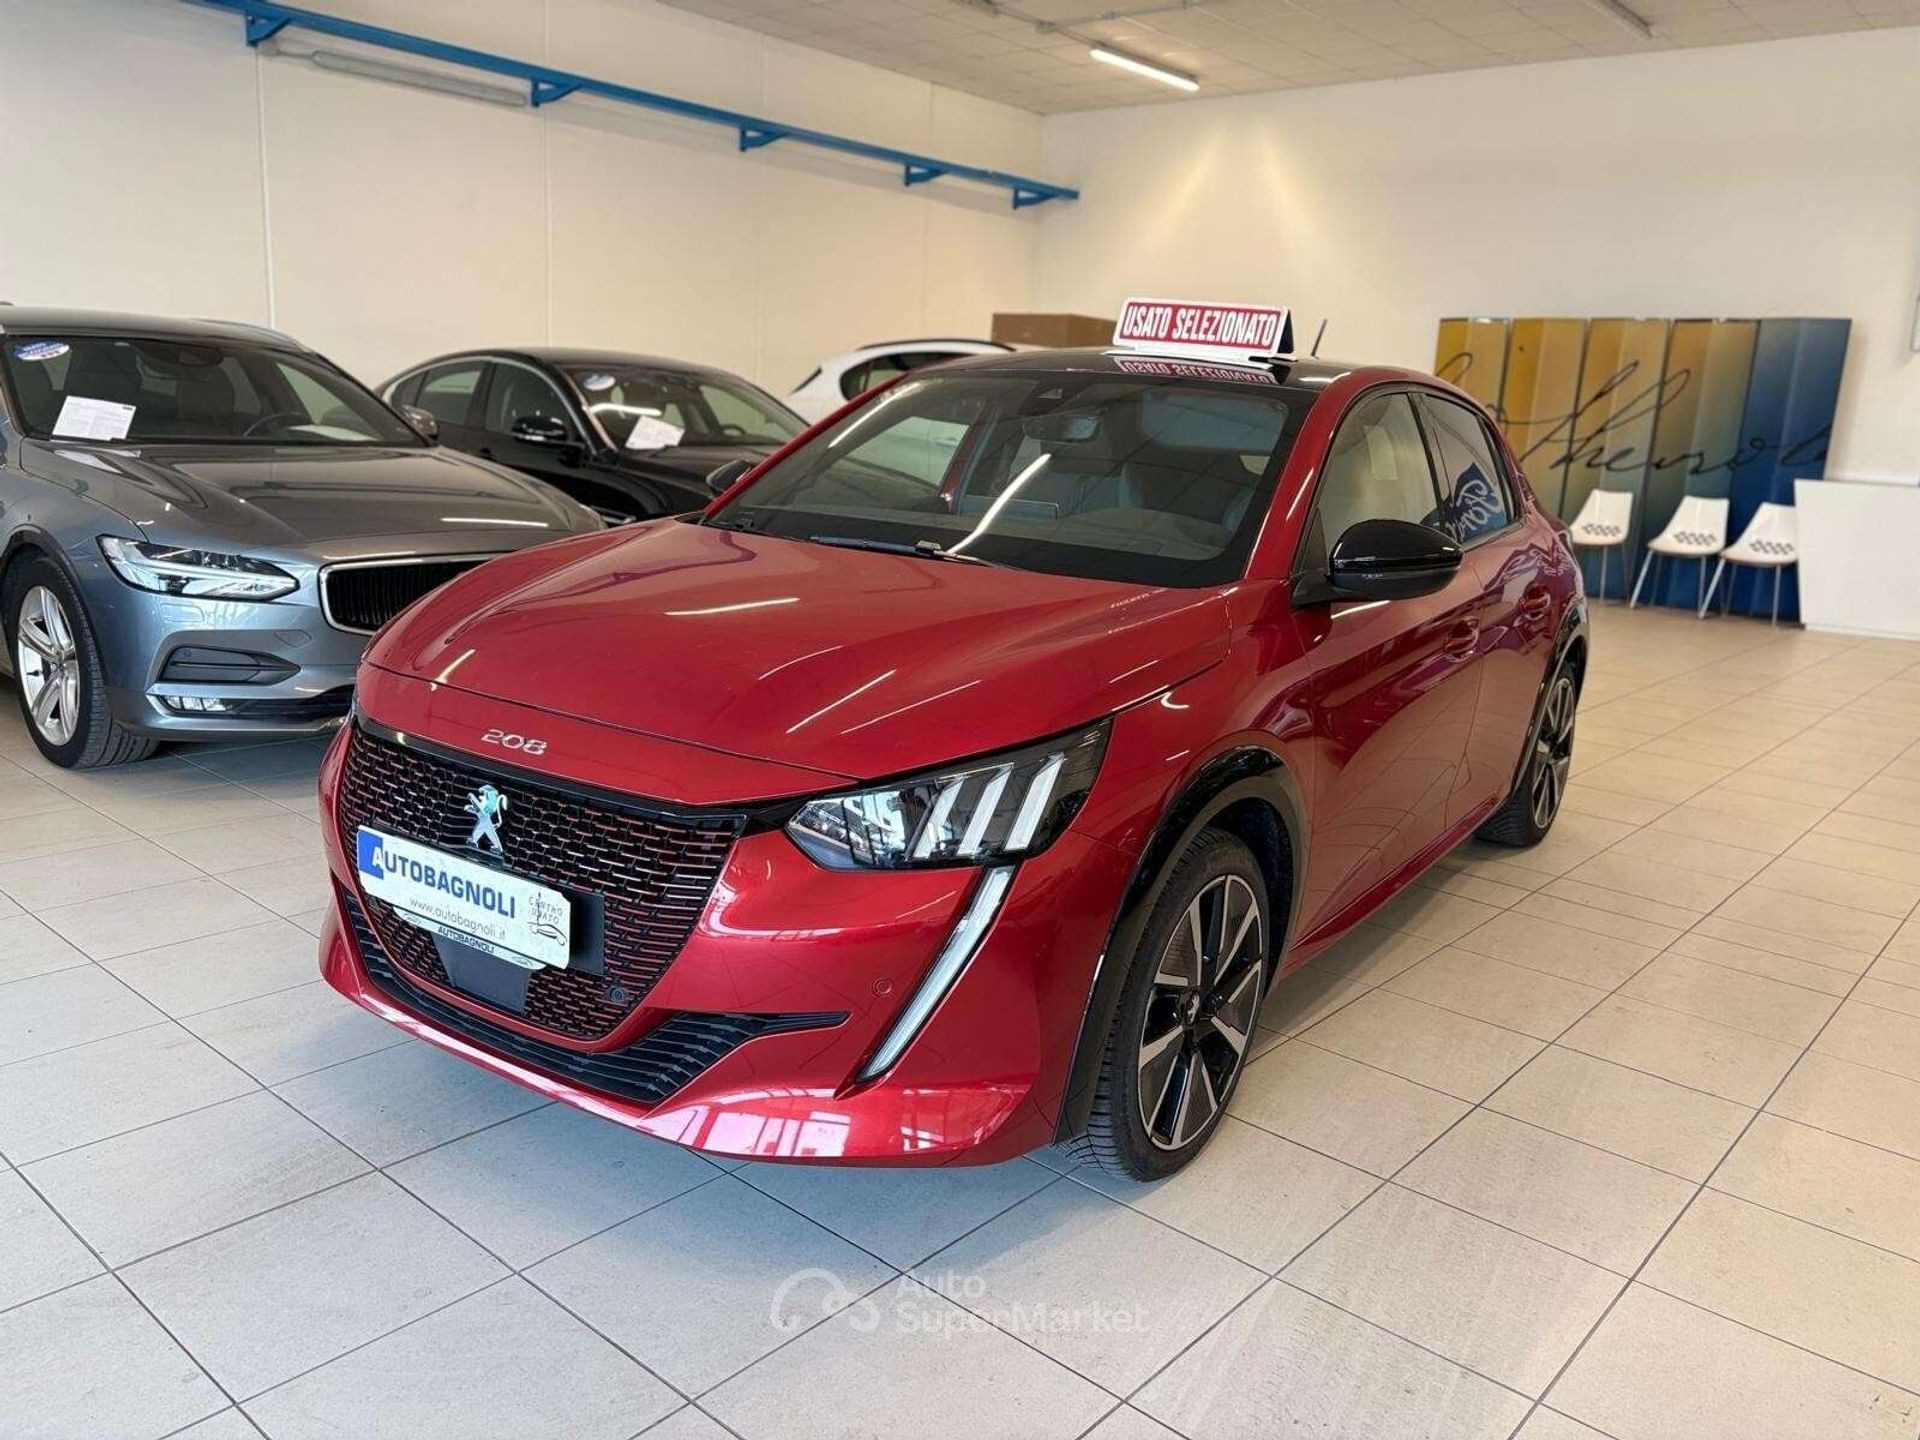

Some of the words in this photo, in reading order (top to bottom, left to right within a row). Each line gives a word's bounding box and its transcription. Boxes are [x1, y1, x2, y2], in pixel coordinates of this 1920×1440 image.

[1123, 305, 1173, 338] USATO
[1172, 308, 1278, 347] SELEZIONATO
[481, 728, 548, 756] 208
[372, 850, 516, 919] AUTOBAGNOLI
[409, 897, 506, 942] www.autobagnoli.it
[437, 926, 495, 954] AUTOBAGNOLI
